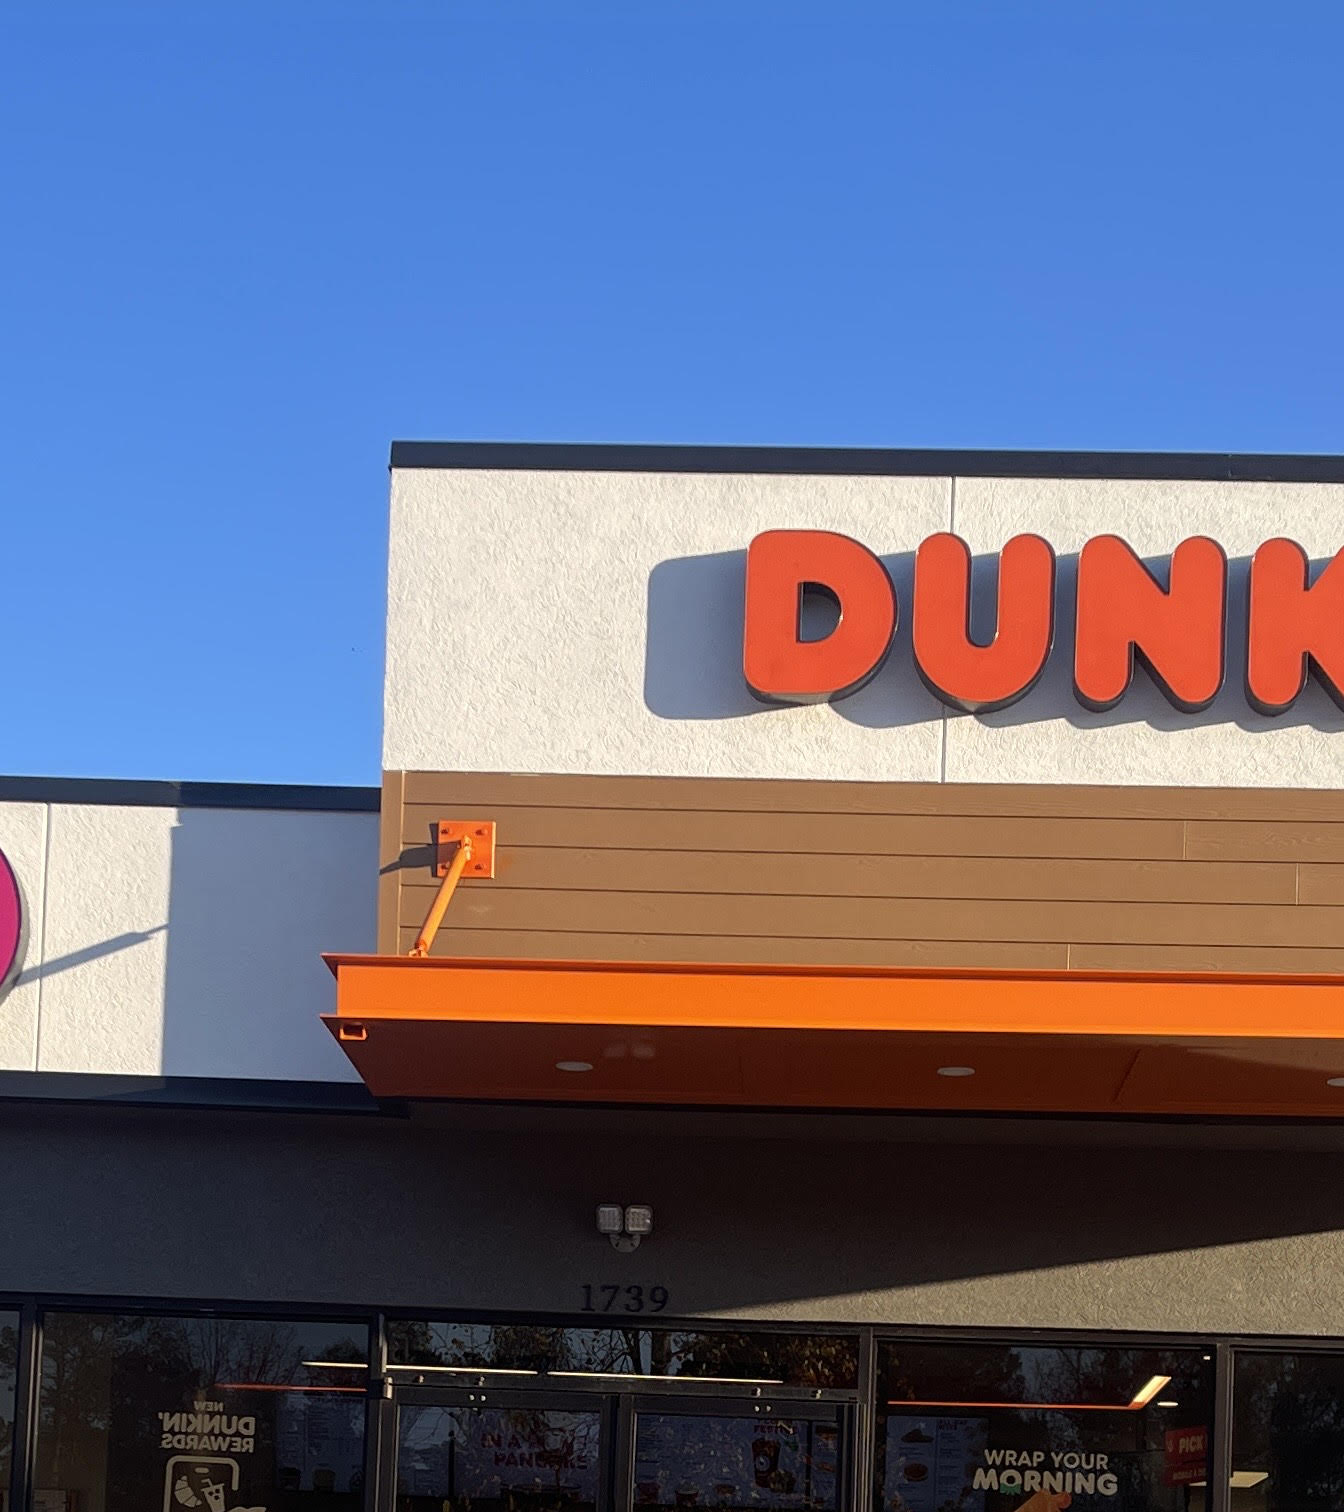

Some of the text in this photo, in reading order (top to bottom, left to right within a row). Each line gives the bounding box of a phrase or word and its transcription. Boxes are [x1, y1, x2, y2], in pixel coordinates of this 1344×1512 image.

[581, 1284, 668, 1312] 1739
[984, 1449, 1109, 1470] WRAP YOUR
[972, 1467, 1118, 1496] MORNING
